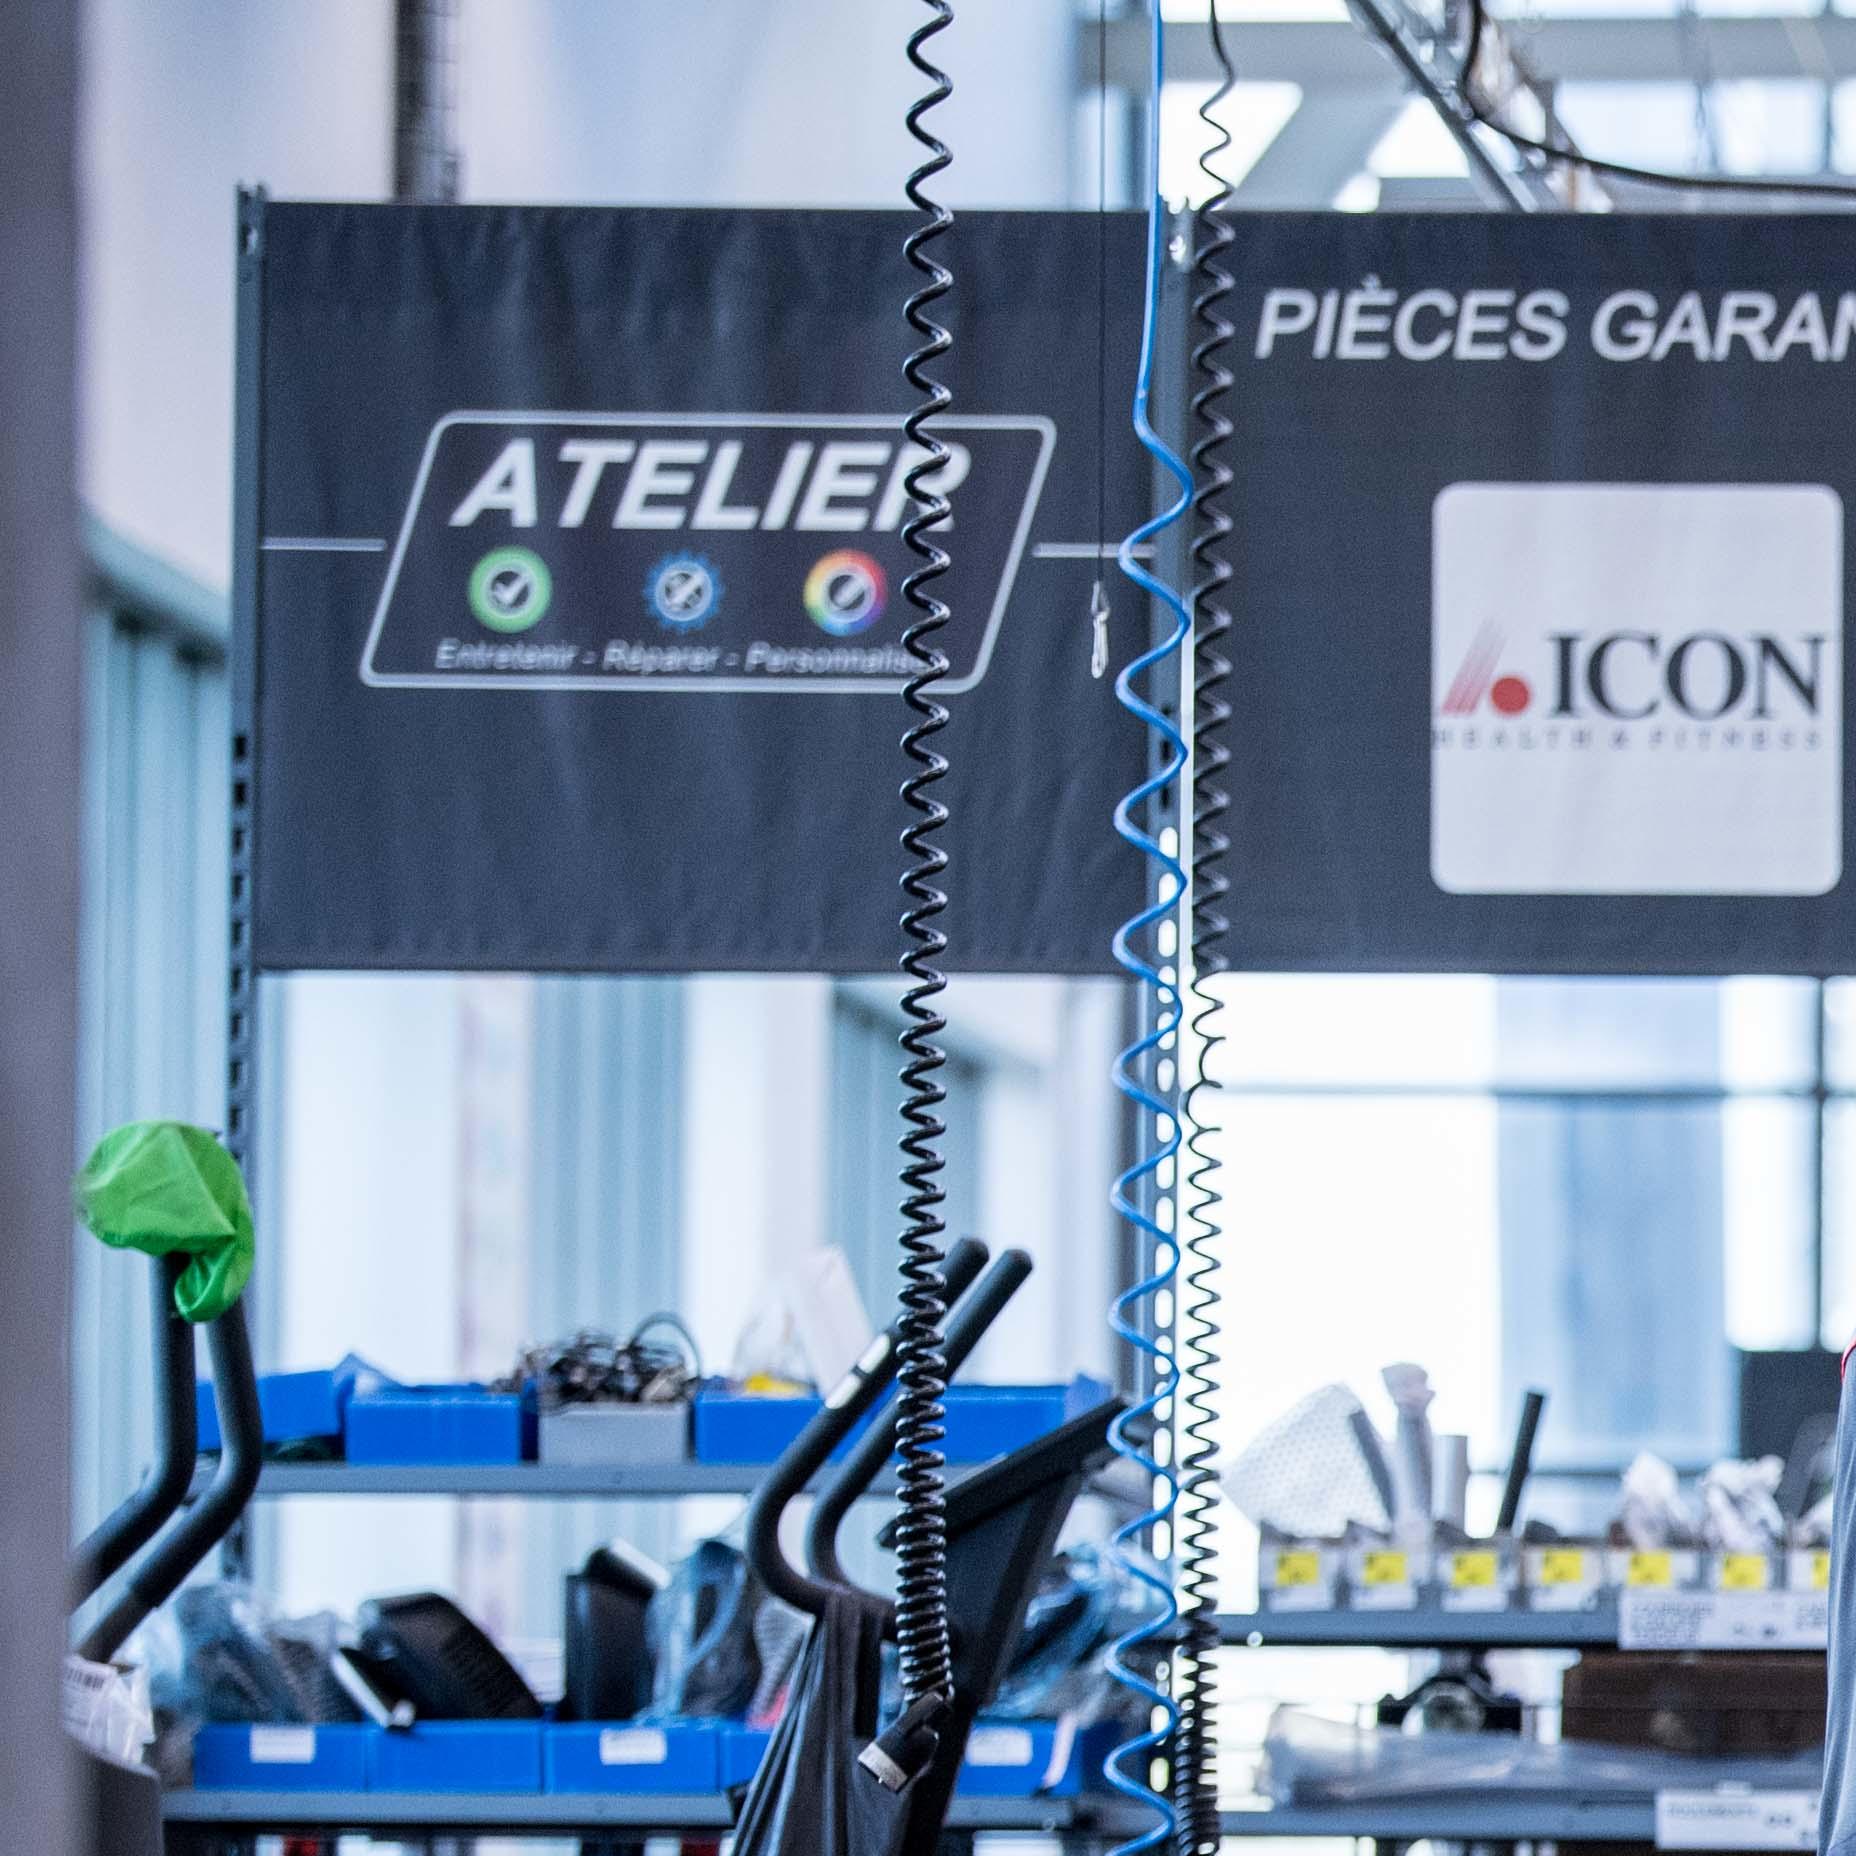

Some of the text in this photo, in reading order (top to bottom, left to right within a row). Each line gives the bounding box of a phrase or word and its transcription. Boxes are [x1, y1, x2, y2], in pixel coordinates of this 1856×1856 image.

[1254, 274, 1571, 361] PIÈCES
[449, 438, 971, 531] ATELIER
[1548, 631, 1828, 721] ICON
